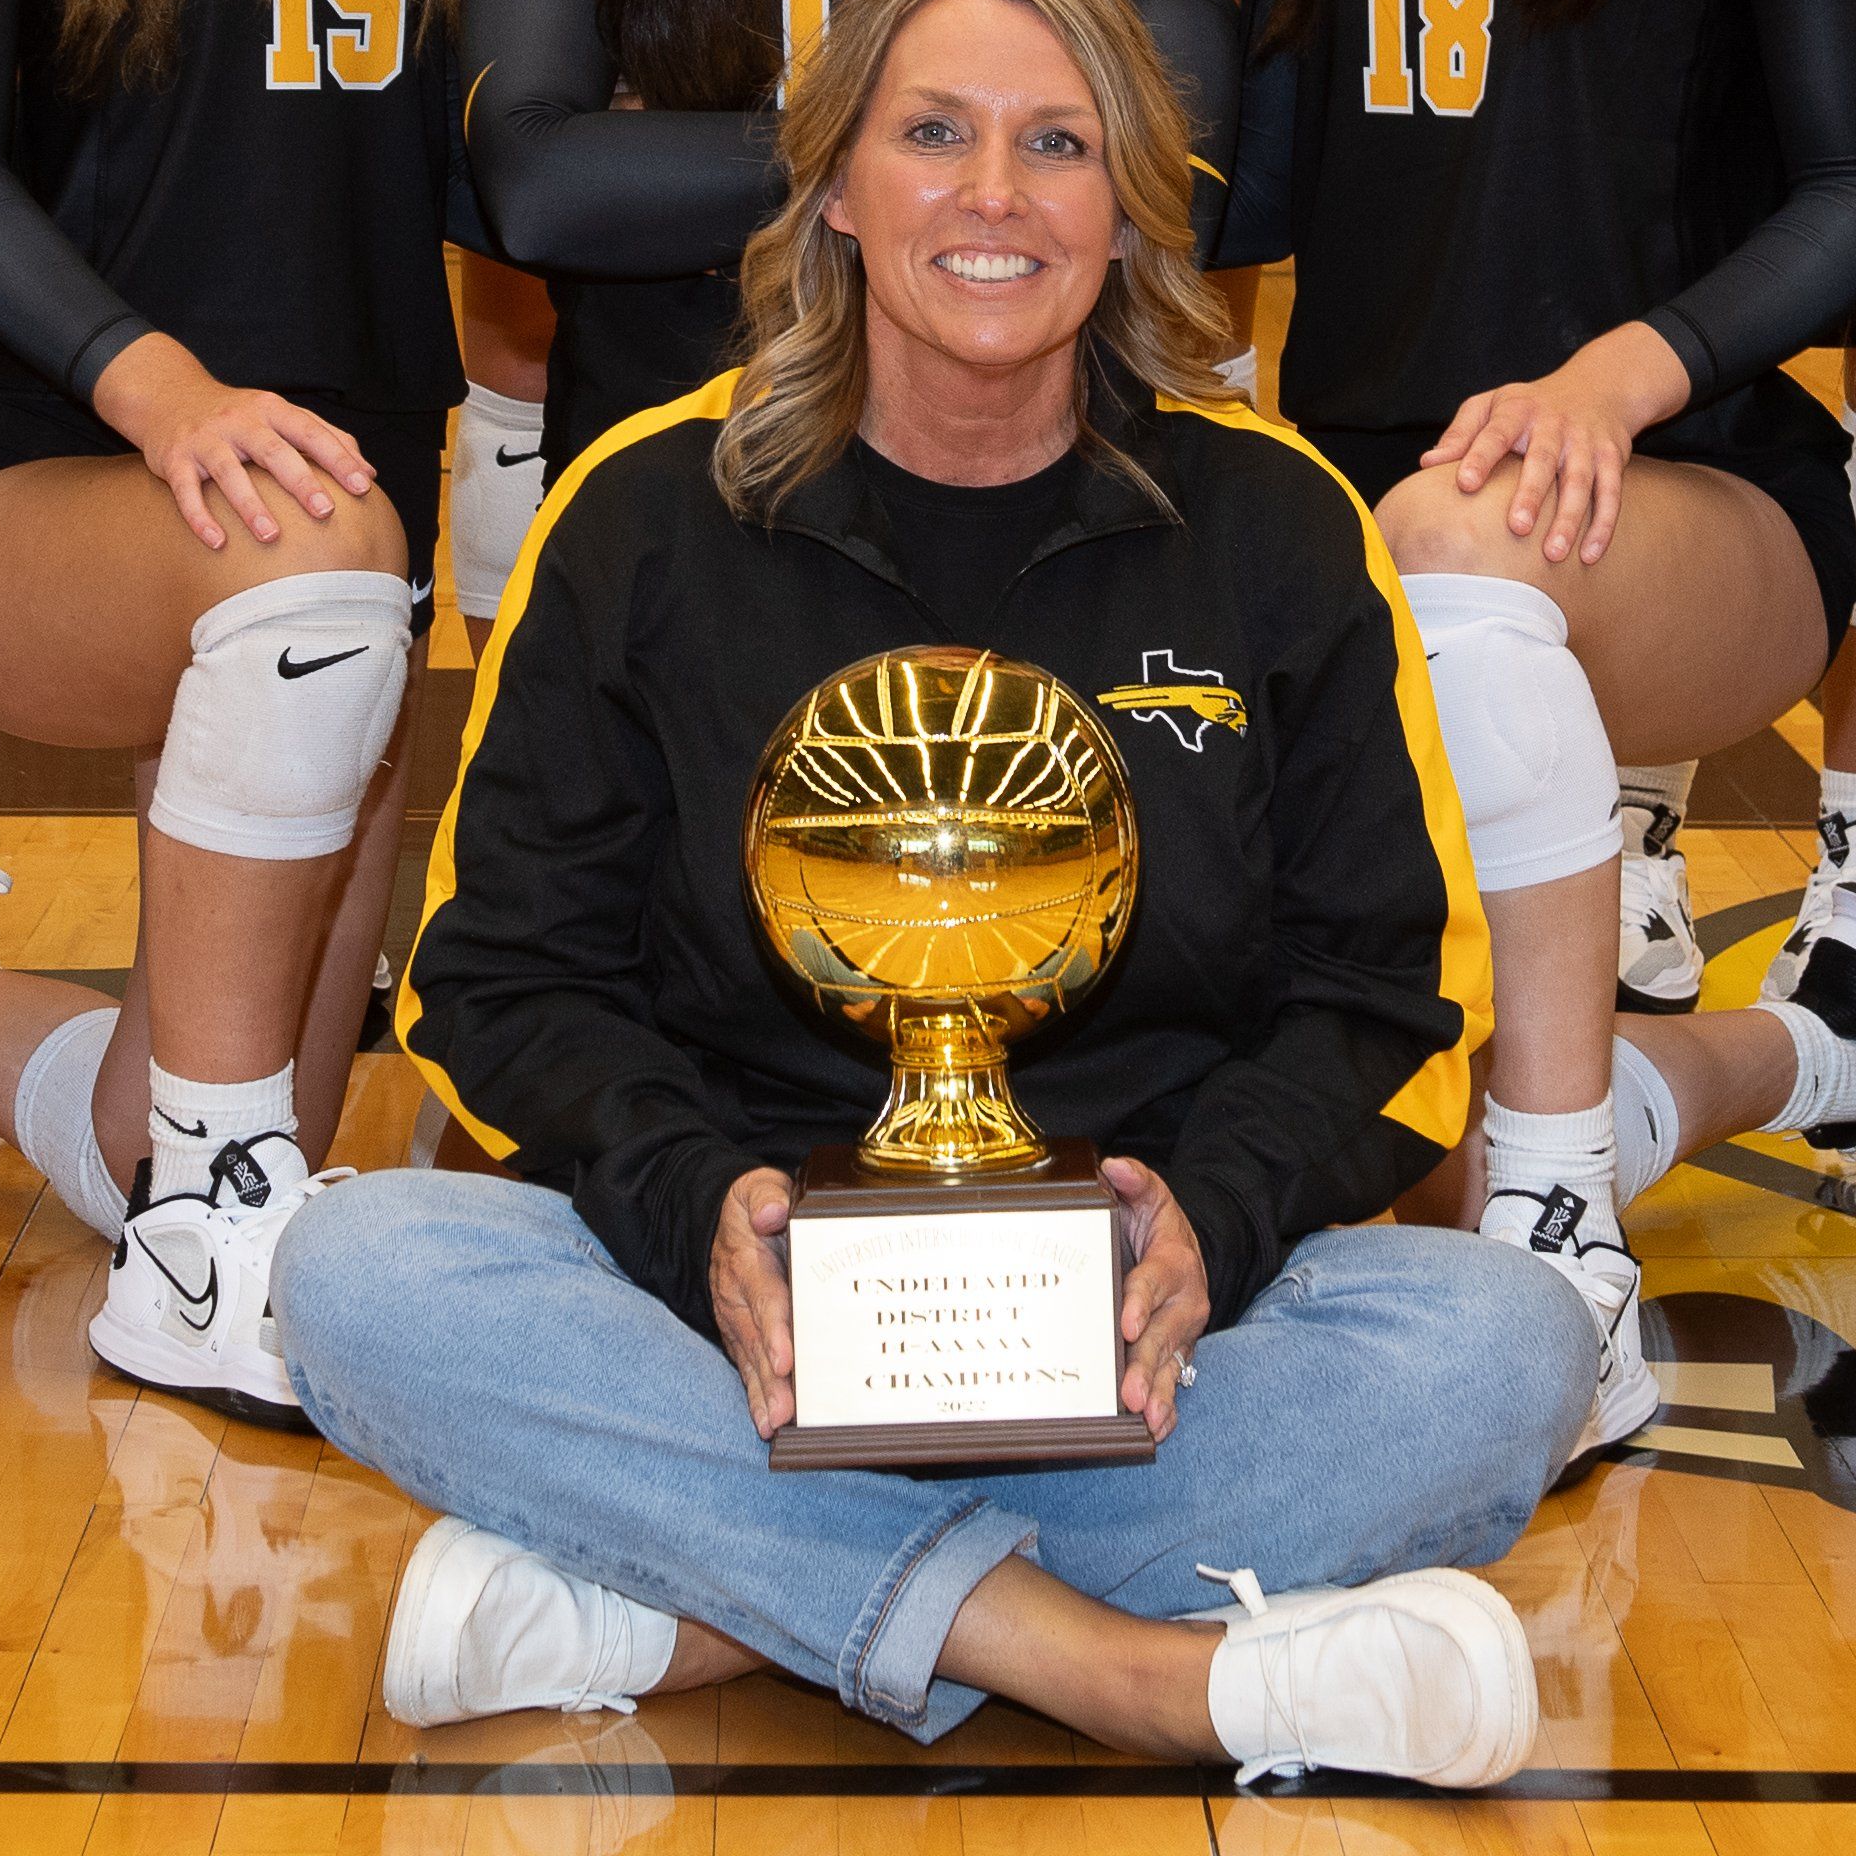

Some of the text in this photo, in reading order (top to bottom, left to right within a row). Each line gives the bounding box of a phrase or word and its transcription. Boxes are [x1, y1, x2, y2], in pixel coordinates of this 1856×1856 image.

[852, 1273, 1062, 1295] UNDEFEATED
[877, 1306, 1025, 1326] DISTRICT
[864, 1367, 1081, 1389] CHAMPIONS
